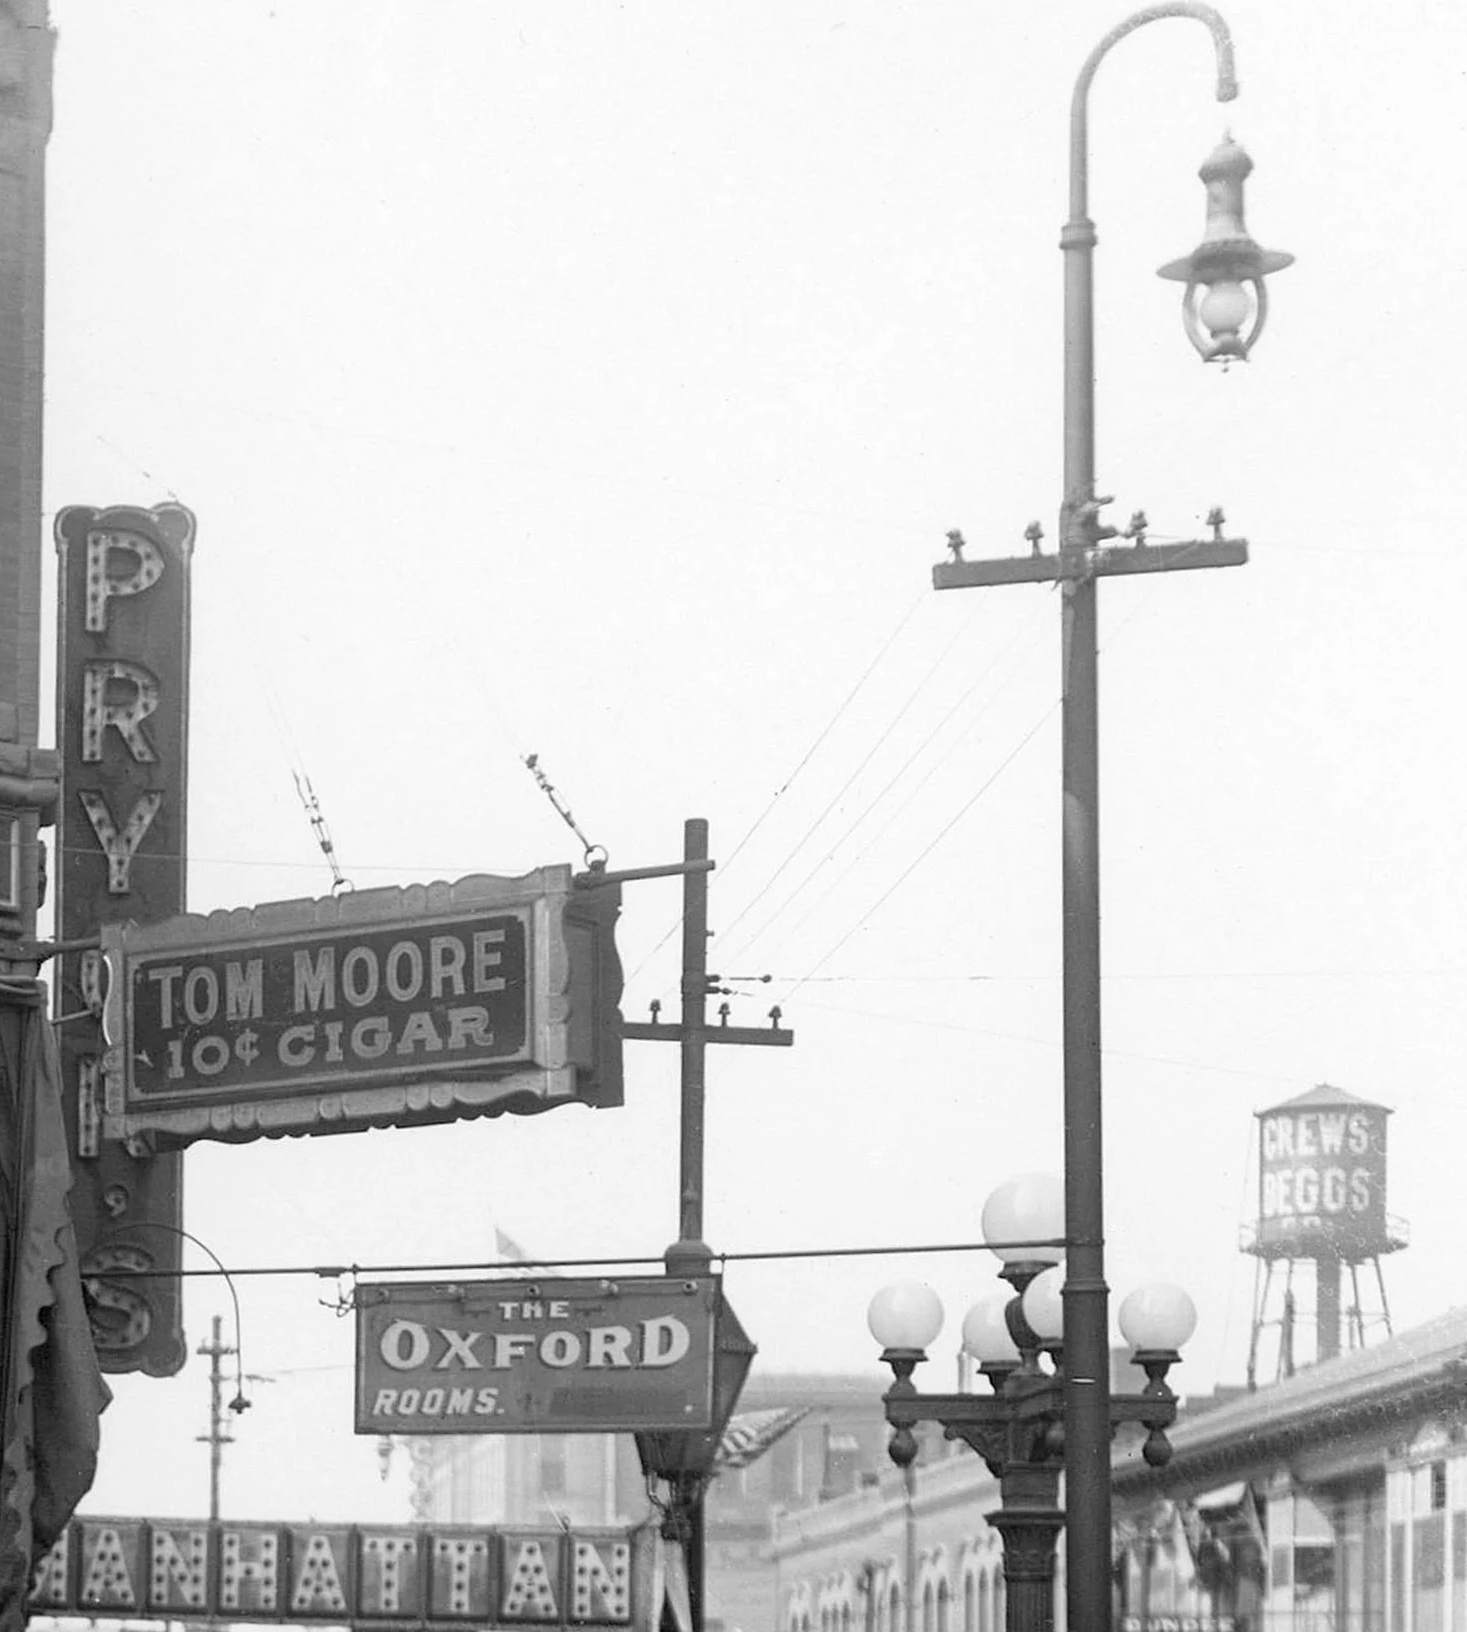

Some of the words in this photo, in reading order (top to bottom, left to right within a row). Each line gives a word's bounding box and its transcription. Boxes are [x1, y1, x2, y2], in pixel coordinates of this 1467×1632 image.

[148, 959, 265, 1029] TOM
[293, 929, 507, 1013] MOORE
[166, 1028, 261, 1079] 10¢
[278, 1006, 494, 1068] CIGAR
[380, 1314, 692, 1369] OXFORD
[497, 1300, 570, 1320] THE
